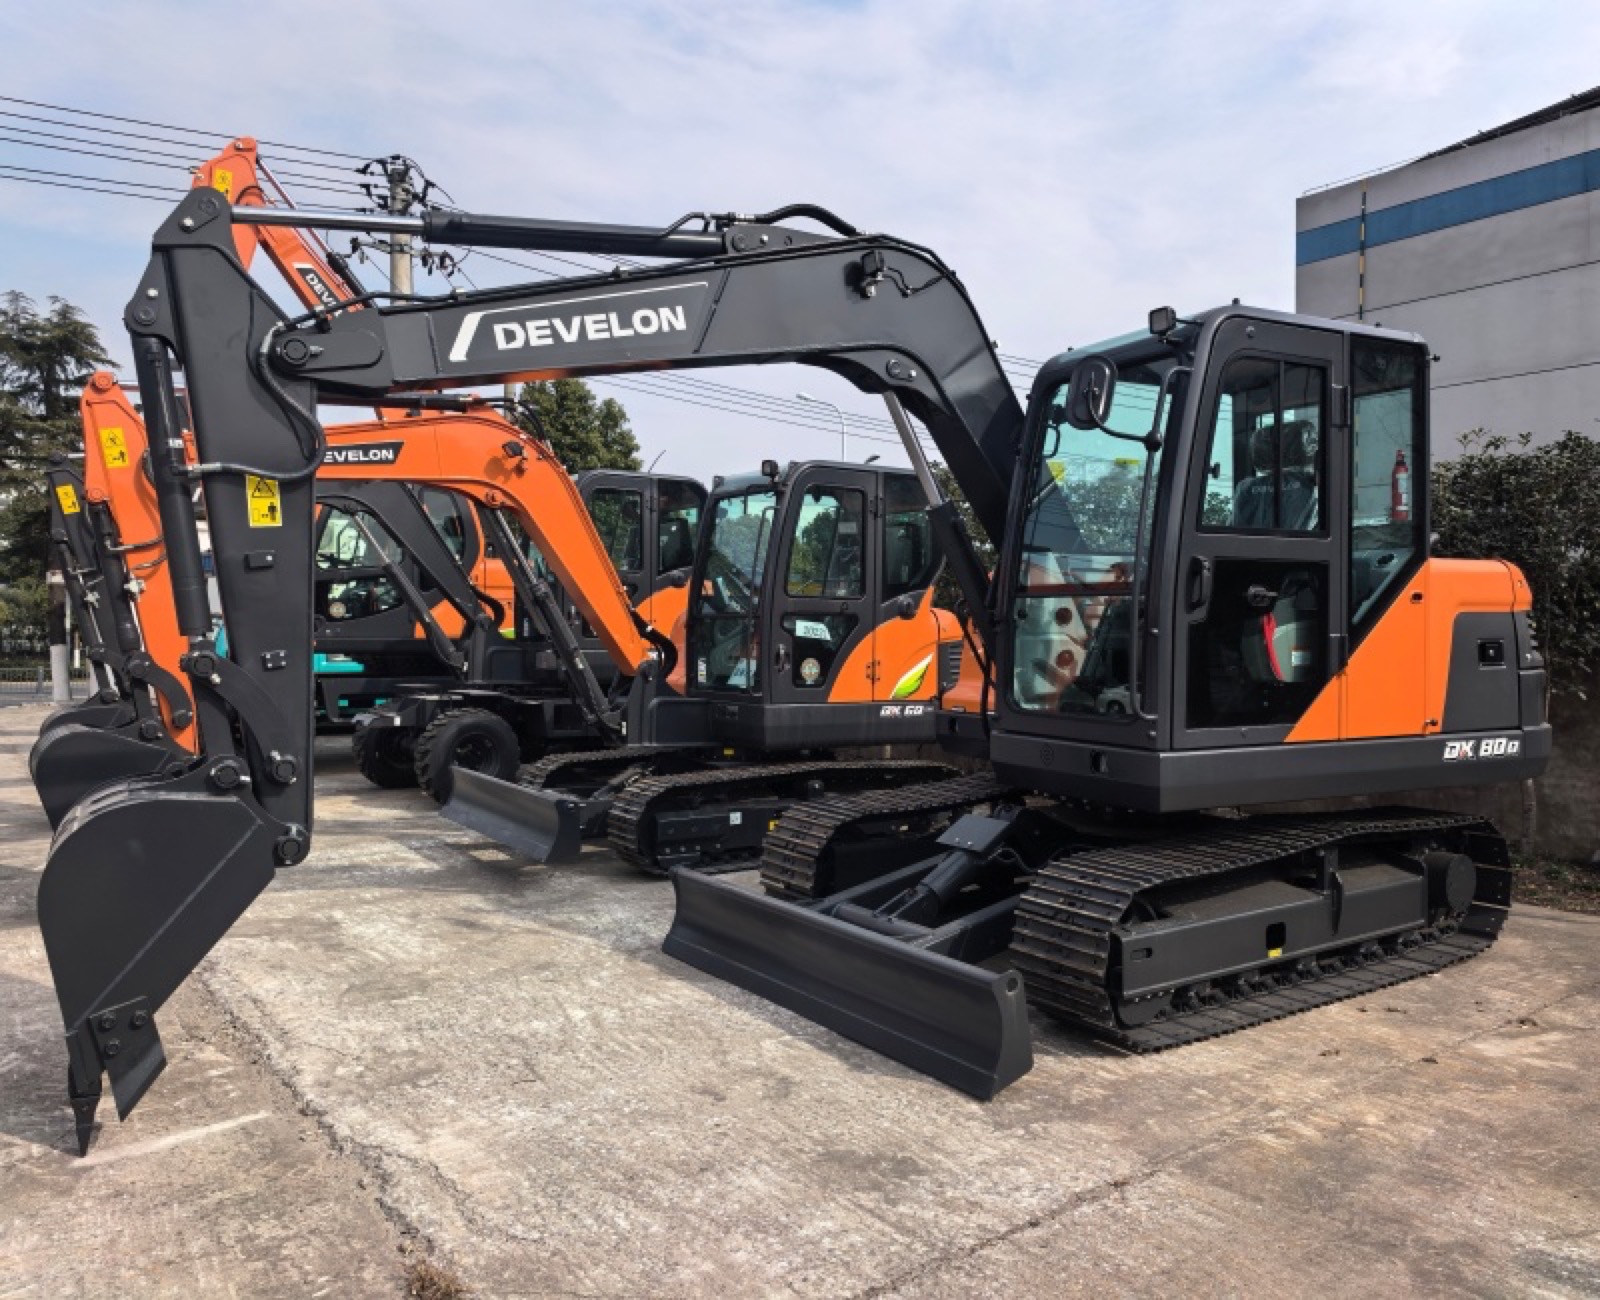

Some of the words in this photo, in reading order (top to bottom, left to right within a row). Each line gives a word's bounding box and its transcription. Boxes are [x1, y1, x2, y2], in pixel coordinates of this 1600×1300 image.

[493, 305, 687, 350] DEVELON
[323, 449, 394, 463] EVELON
[1442, 740, 1476, 761] DX
